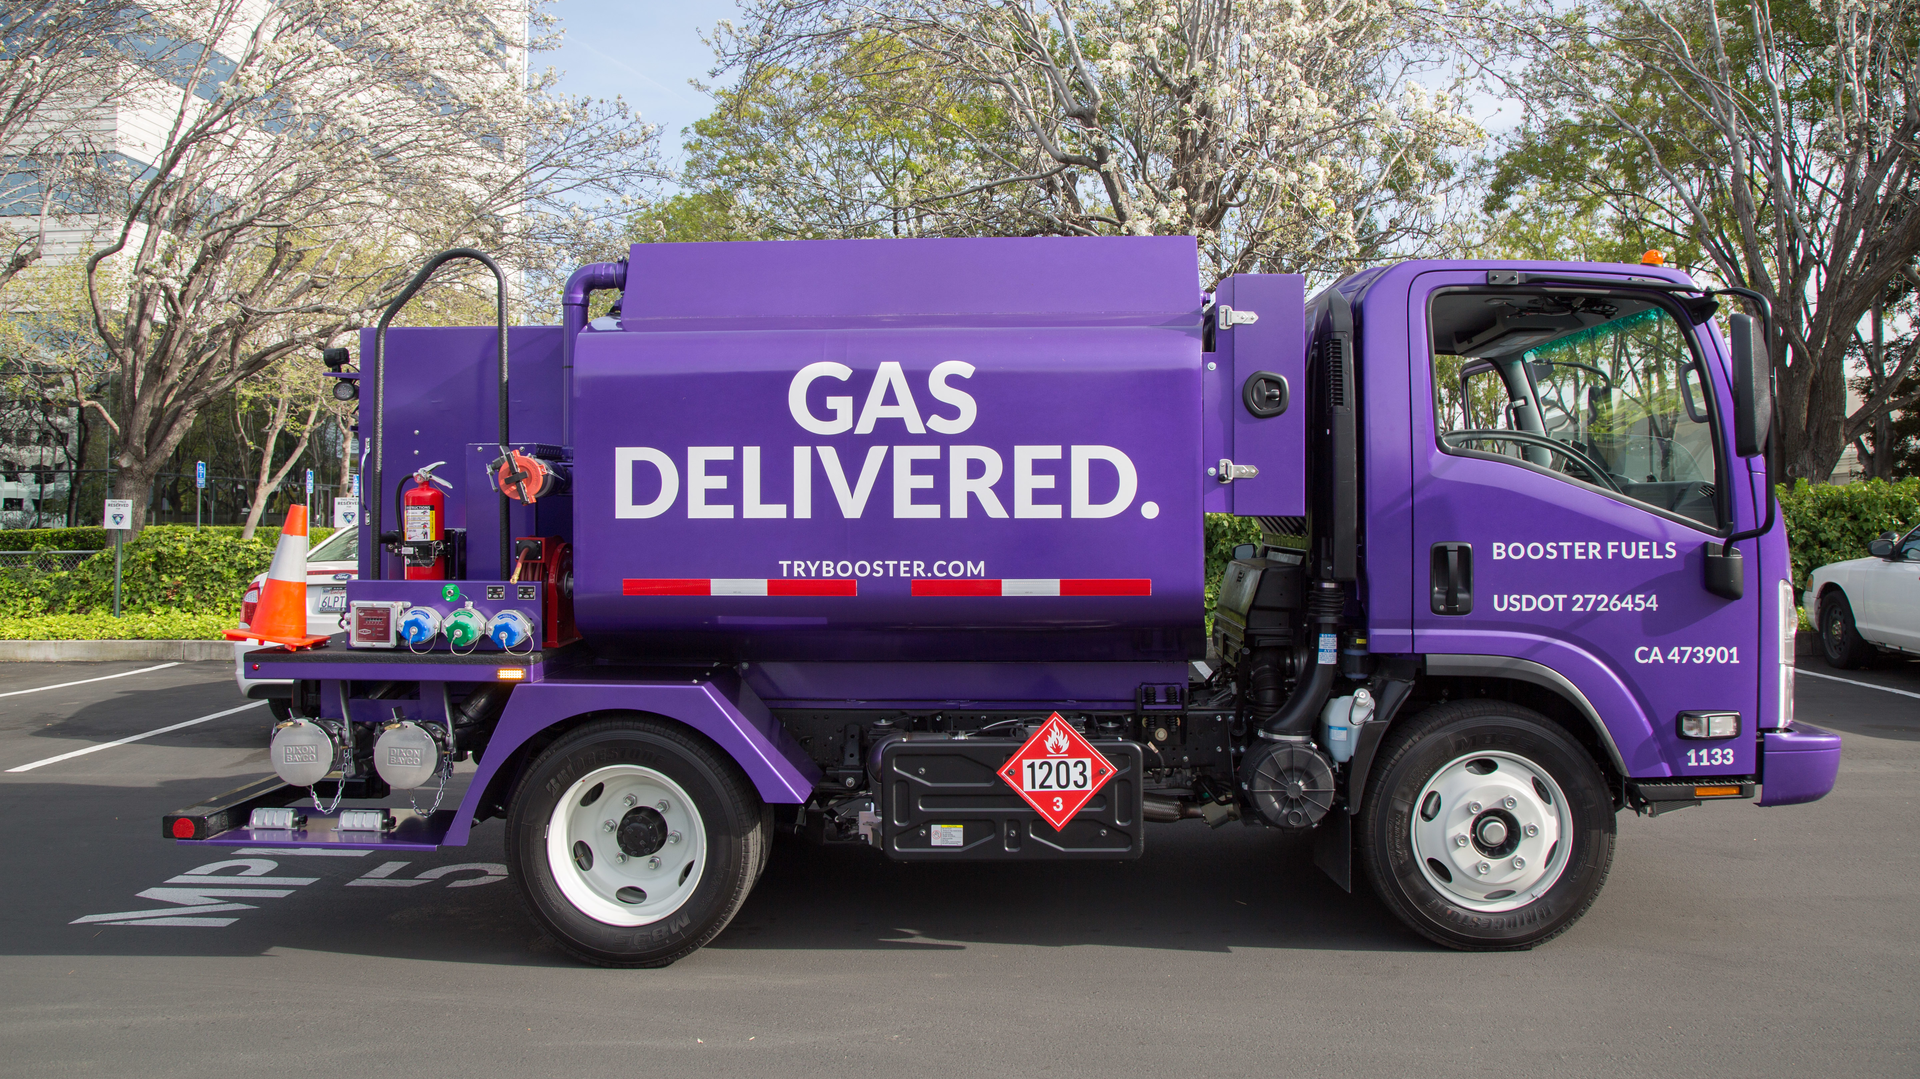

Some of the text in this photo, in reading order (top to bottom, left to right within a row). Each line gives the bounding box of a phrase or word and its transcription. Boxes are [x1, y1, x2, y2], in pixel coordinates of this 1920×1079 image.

[788, 360, 978, 435] GAS
[615, 445, 1160, 520] DELIVERED.
[1492, 541, 1677, 560] BOOSTER FUELS
[778, 560, 985, 577] TRYBOOSTER.COM
[321, 595, 346, 608] 6LPT
[1493, 594, 1659, 612] USDOT 2726454
[1634, 646, 1740, 664] CA 473901
[286, 745, 316, 755] DIXON
[286, 754, 316, 763] BAYCO
[390, 748, 421, 758] DIXON
[1687, 748, 1734, 767] 1133
[390, 756, 421, 766] BAYCO
[1026, 760, 1088, 789] 1203
[1052, 796, 1064, 812] 3
